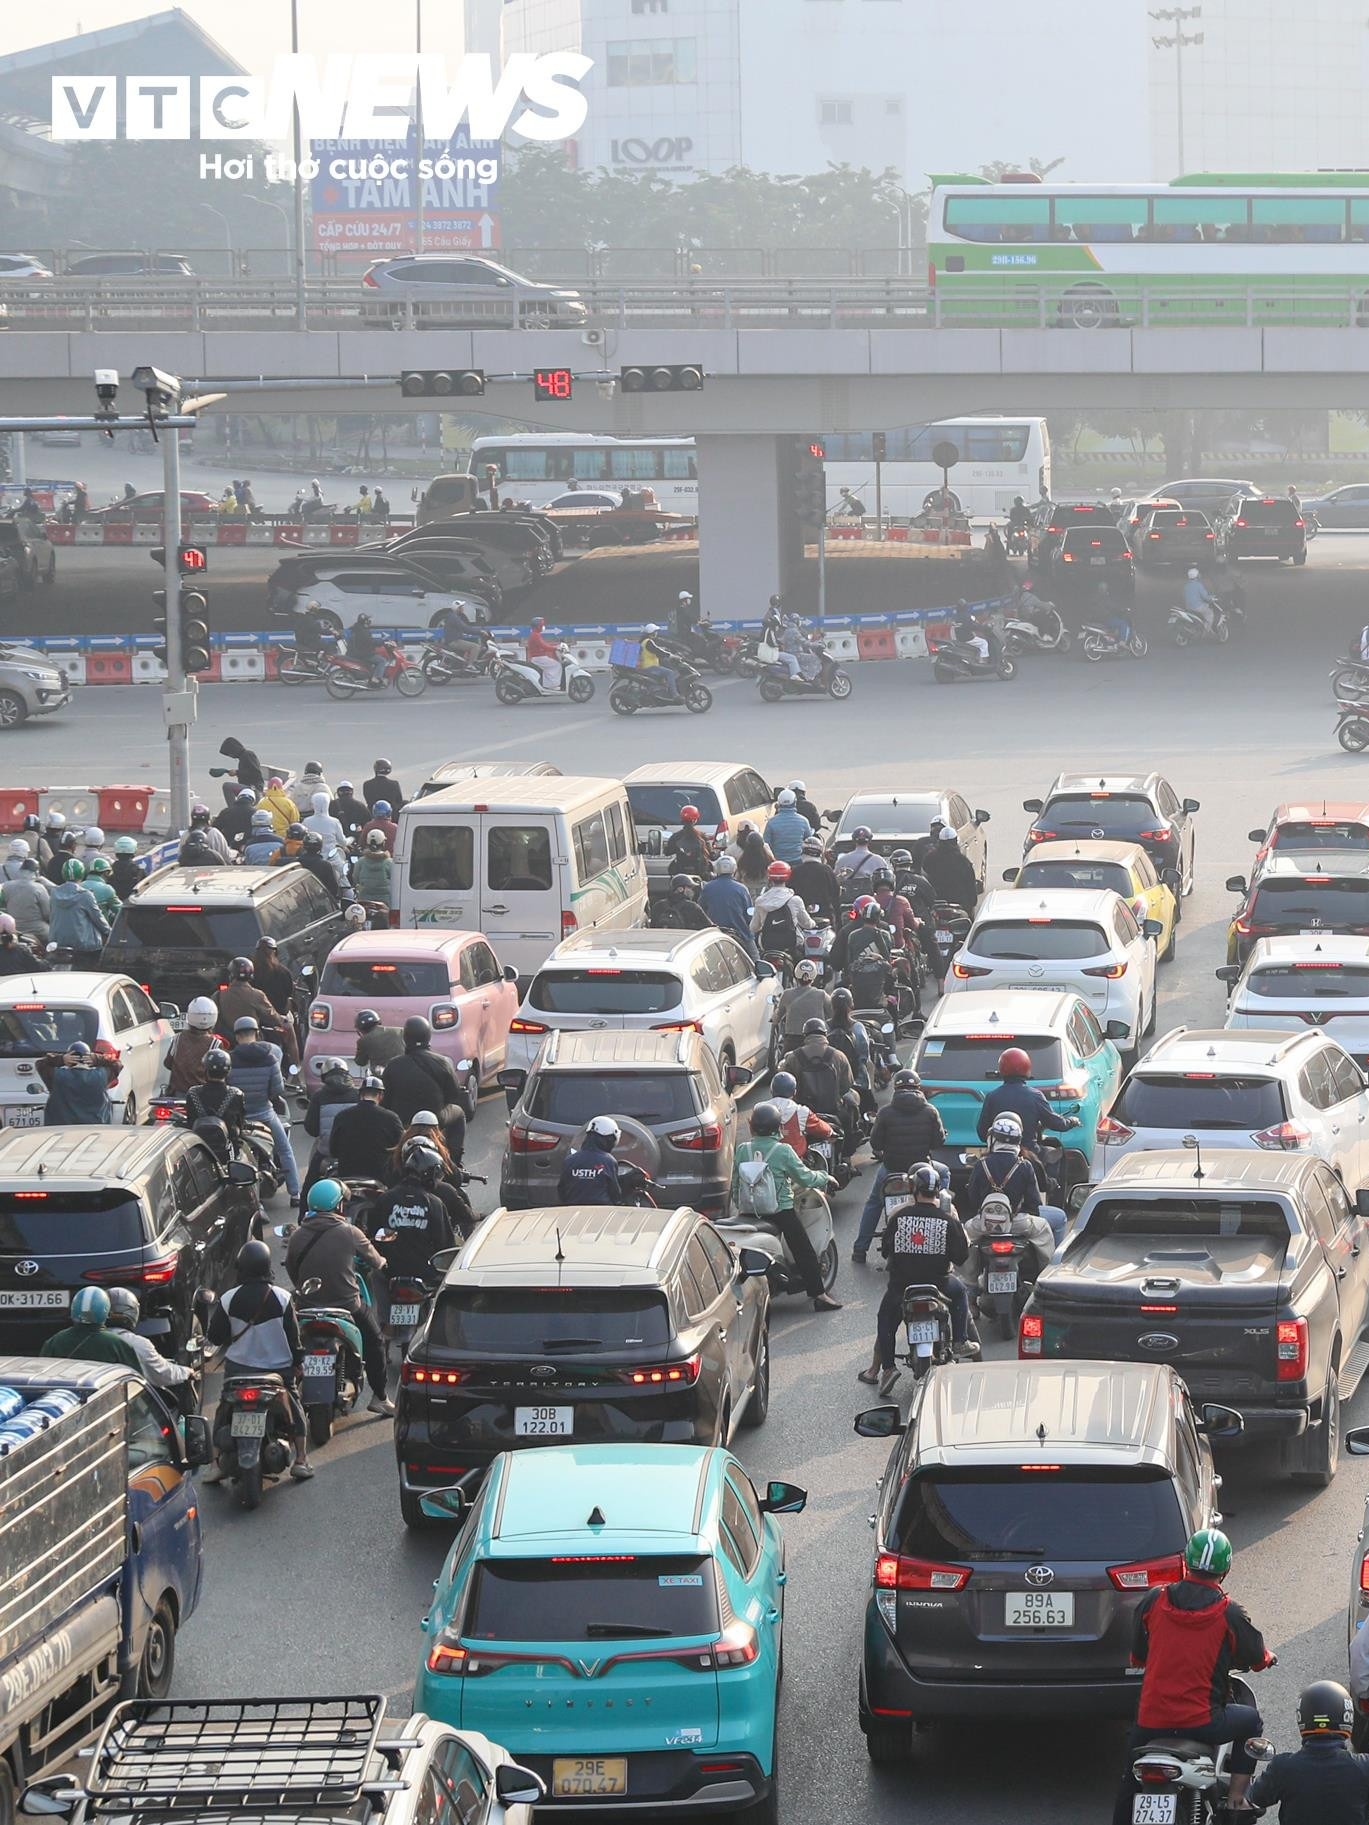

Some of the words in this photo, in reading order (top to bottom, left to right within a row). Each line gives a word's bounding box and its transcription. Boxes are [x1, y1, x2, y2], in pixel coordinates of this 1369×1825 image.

[611, 137, 693, 163] LOOP
[372, 223, 401, 236] 24/7
[537, 371, 571, 397] 48
[572, 1169, 596, 1177] USTH
[531, 1408, 556, 1419] 30B
[522, 1421, 565, 1433] 122.01
[664, 1576, 675, 1584] XE
[680, 1576, 699, 1584] TAXI
[1025, 1594, 1053, 1608] 89A
[1012, 1610, 1066, 1624] 256.63
[575, 1761, 605, 1776] 29E
[561, 1777, 619, 1795] 070.47
[1139, 1796, 1170, 1809] 29-L5
[1135, 1810, 1171, 1823] 274.37
